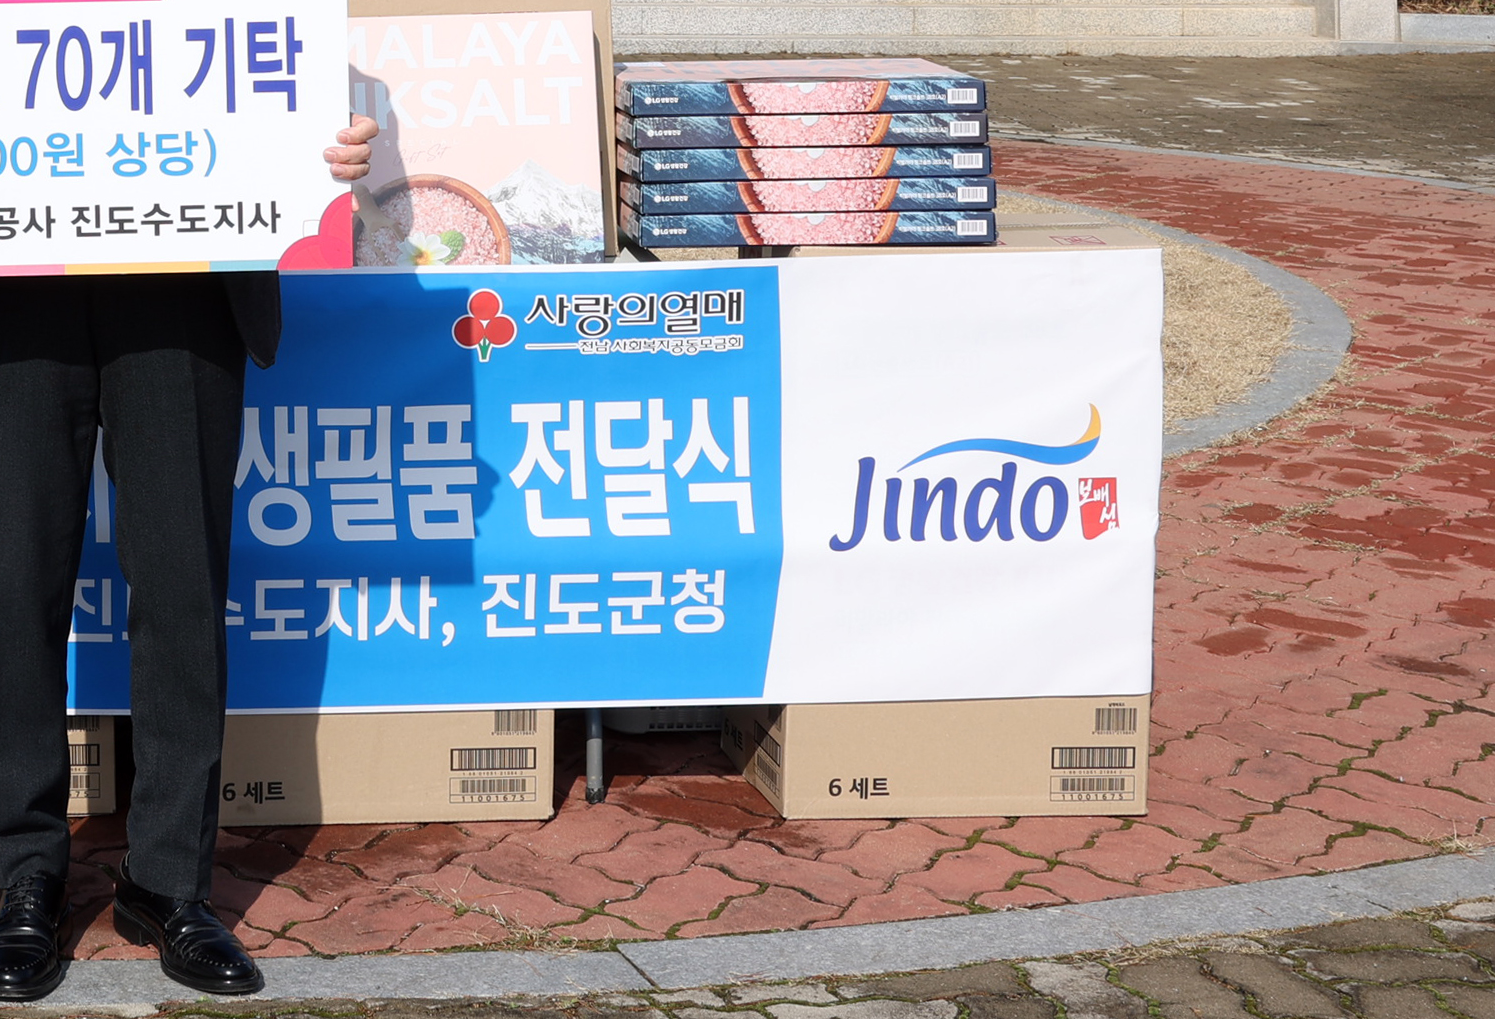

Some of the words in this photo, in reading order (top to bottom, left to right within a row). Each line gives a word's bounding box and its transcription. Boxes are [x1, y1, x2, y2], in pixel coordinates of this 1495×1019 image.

[16, 19, 154, 113] 70개
[183, 15, 303, 113] 기탁
[105, 128, 218, 179] 상당)
[71, 200, 281, 240] 진도수도지사
[525, 290, 744, 337] 사랑의열매
[579, 340, 609, 353] 전남
[612, 336, 742, 355] 사회복지공동모금회
[234, 403, 478, 547] 생필품
[508, 395, 756, 537] 전달식
[828, 456, 1070, 552] Jindo
[481, 568, 727, 638] 진도군청
[222, 782, 237, 802] 6
[243, 780, 286, 805] 세트
[828, 777, 843, 797] 6
[849, 776, 891, 801] 세트
